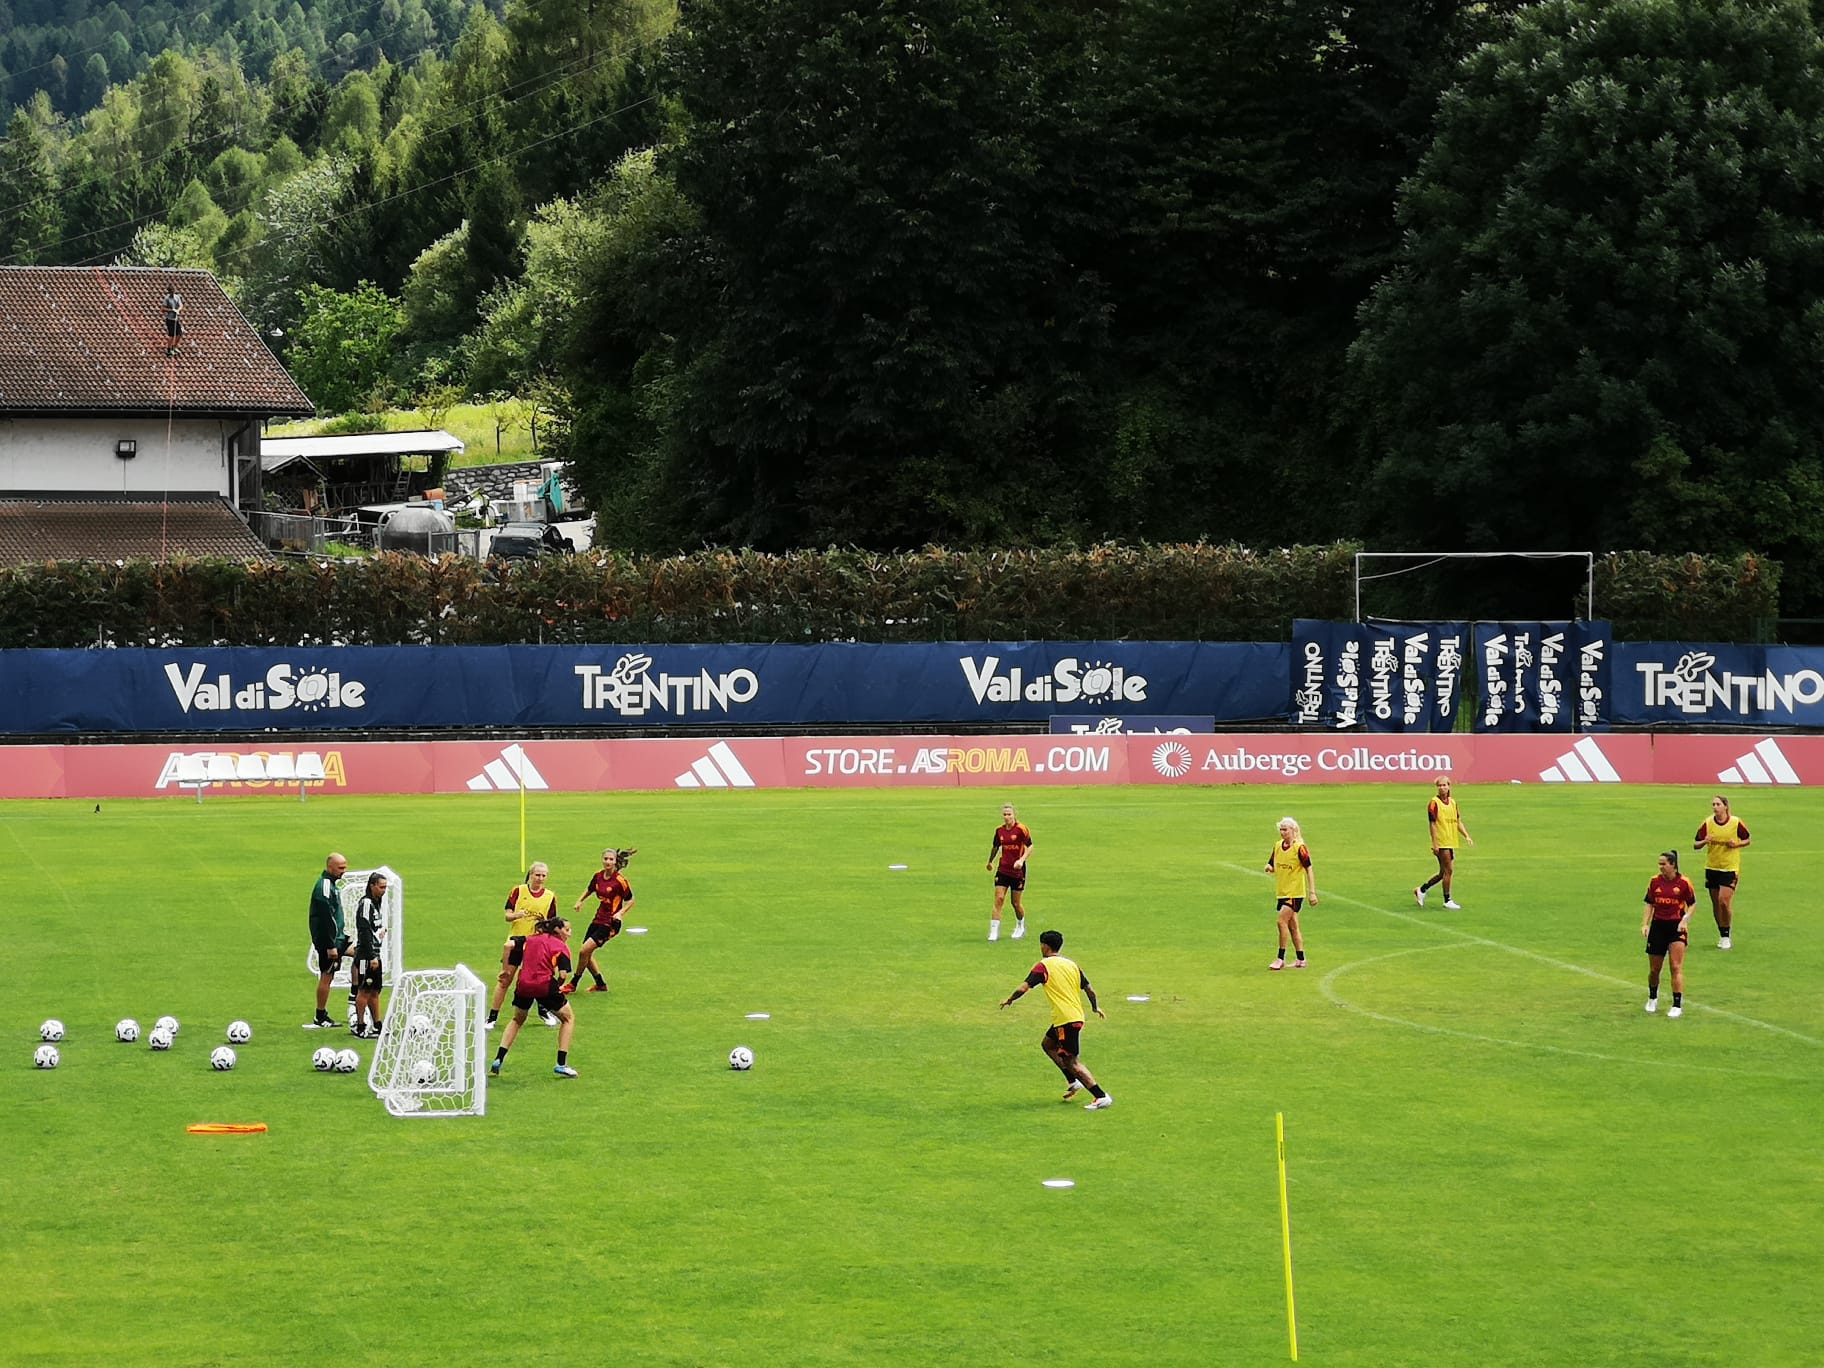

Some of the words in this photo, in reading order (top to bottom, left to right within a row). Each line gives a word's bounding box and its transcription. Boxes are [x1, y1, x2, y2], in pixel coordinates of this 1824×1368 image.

[164, 662, 231, 713] Val
[235, 682, 265, 710] di
[266, 663, 366, 711] Sole
[574, 664, 759, 715] TRENTINO
[960, 656, 1022, 705] Val
[1025, 675, 1052, 702] di
[1053, 658, 1148, 704] Sole
[1636, 662, 1824, 715] TRENTINO
[1201, 747, 1312, 776] Auberge
[1317, 747, 1452, 771] Collection
